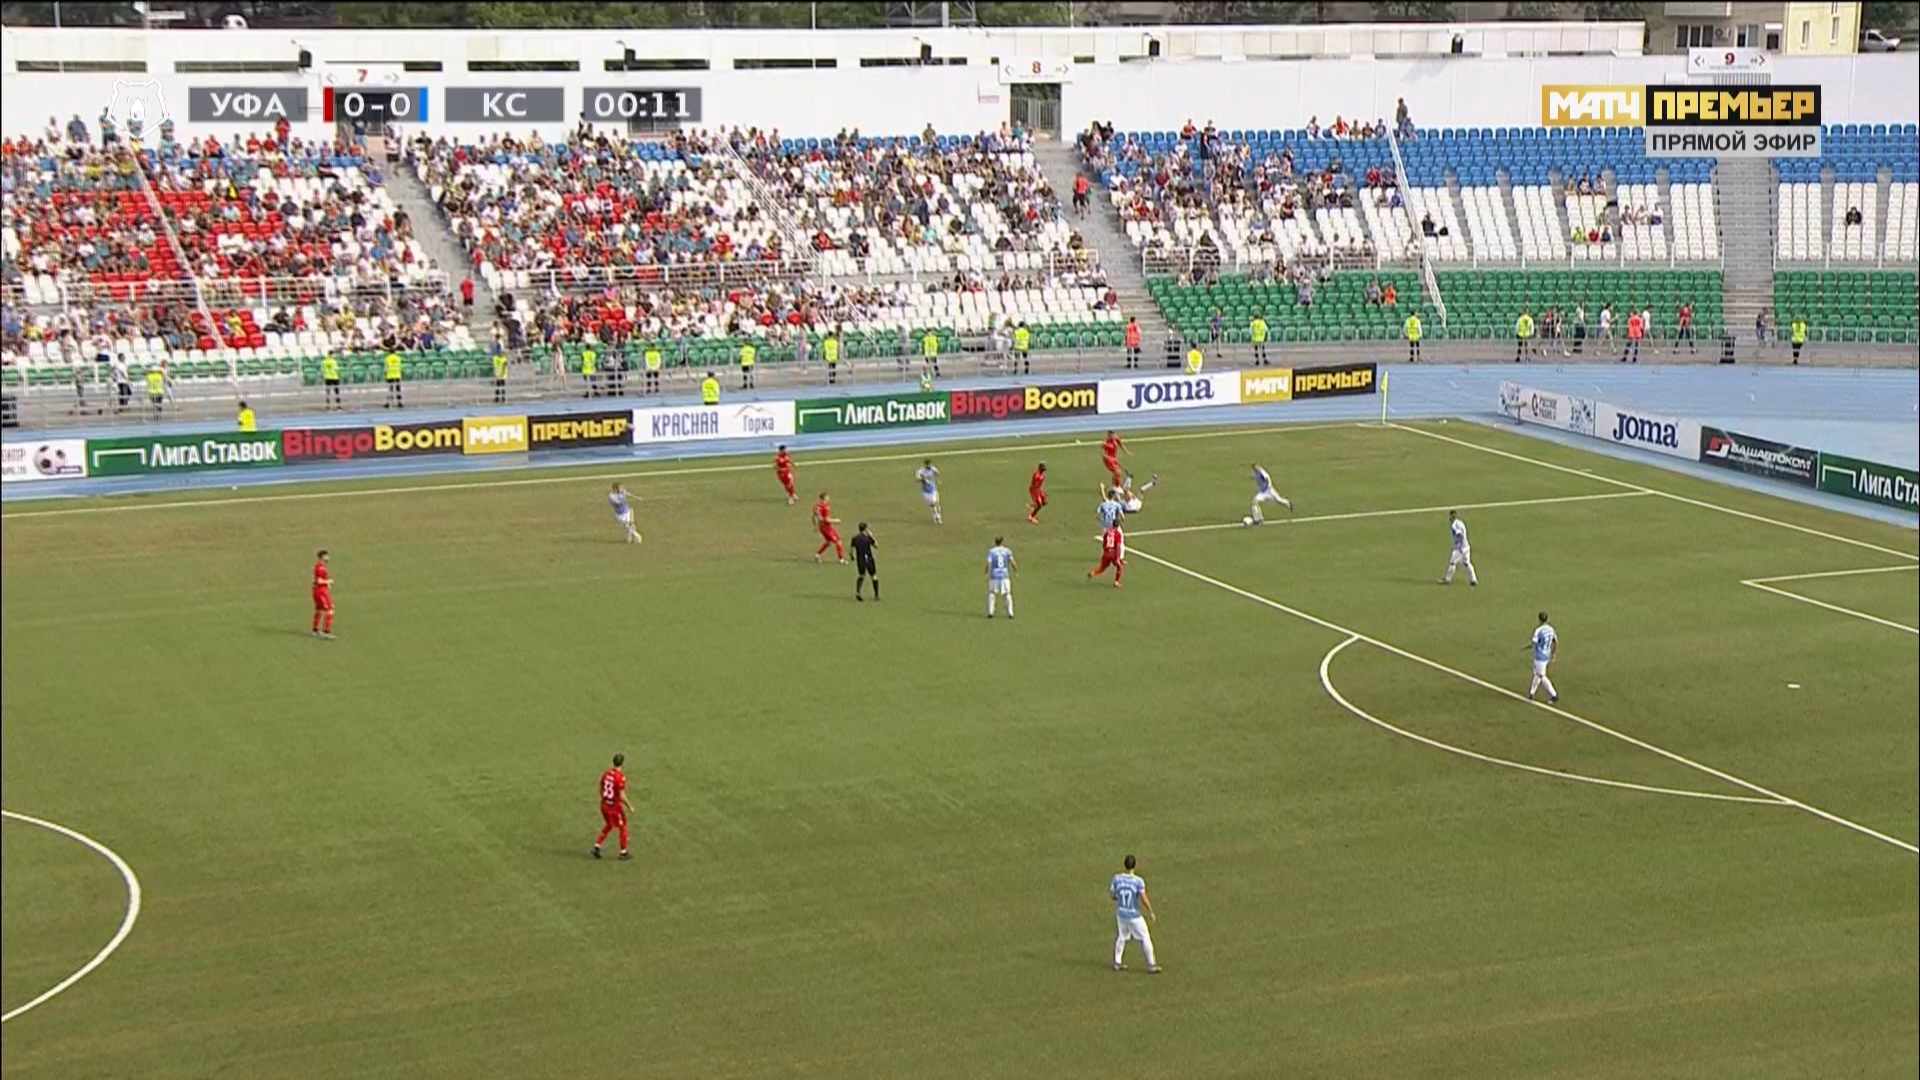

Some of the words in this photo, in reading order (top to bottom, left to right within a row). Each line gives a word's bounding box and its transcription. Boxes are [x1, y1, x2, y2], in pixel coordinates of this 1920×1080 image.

[1725, 52, 1735, 65] 9
[357, 68, 368, 82] 7
[1032, 62, 1042, 74] 8
[1245, 376, 1289, 396] МАТЧ
[1296, 369, 1372, 391] ПРЕМЬЕР
[469, 423, 523, 446] МАТЧ
[532, 419, 626, 441] ПРЕМЬЕР
[652, 411, 719, 437] КРАСНАЯ
[742, 414, 775, 434] Горка
[1120, 890, 1132, 907] 17
